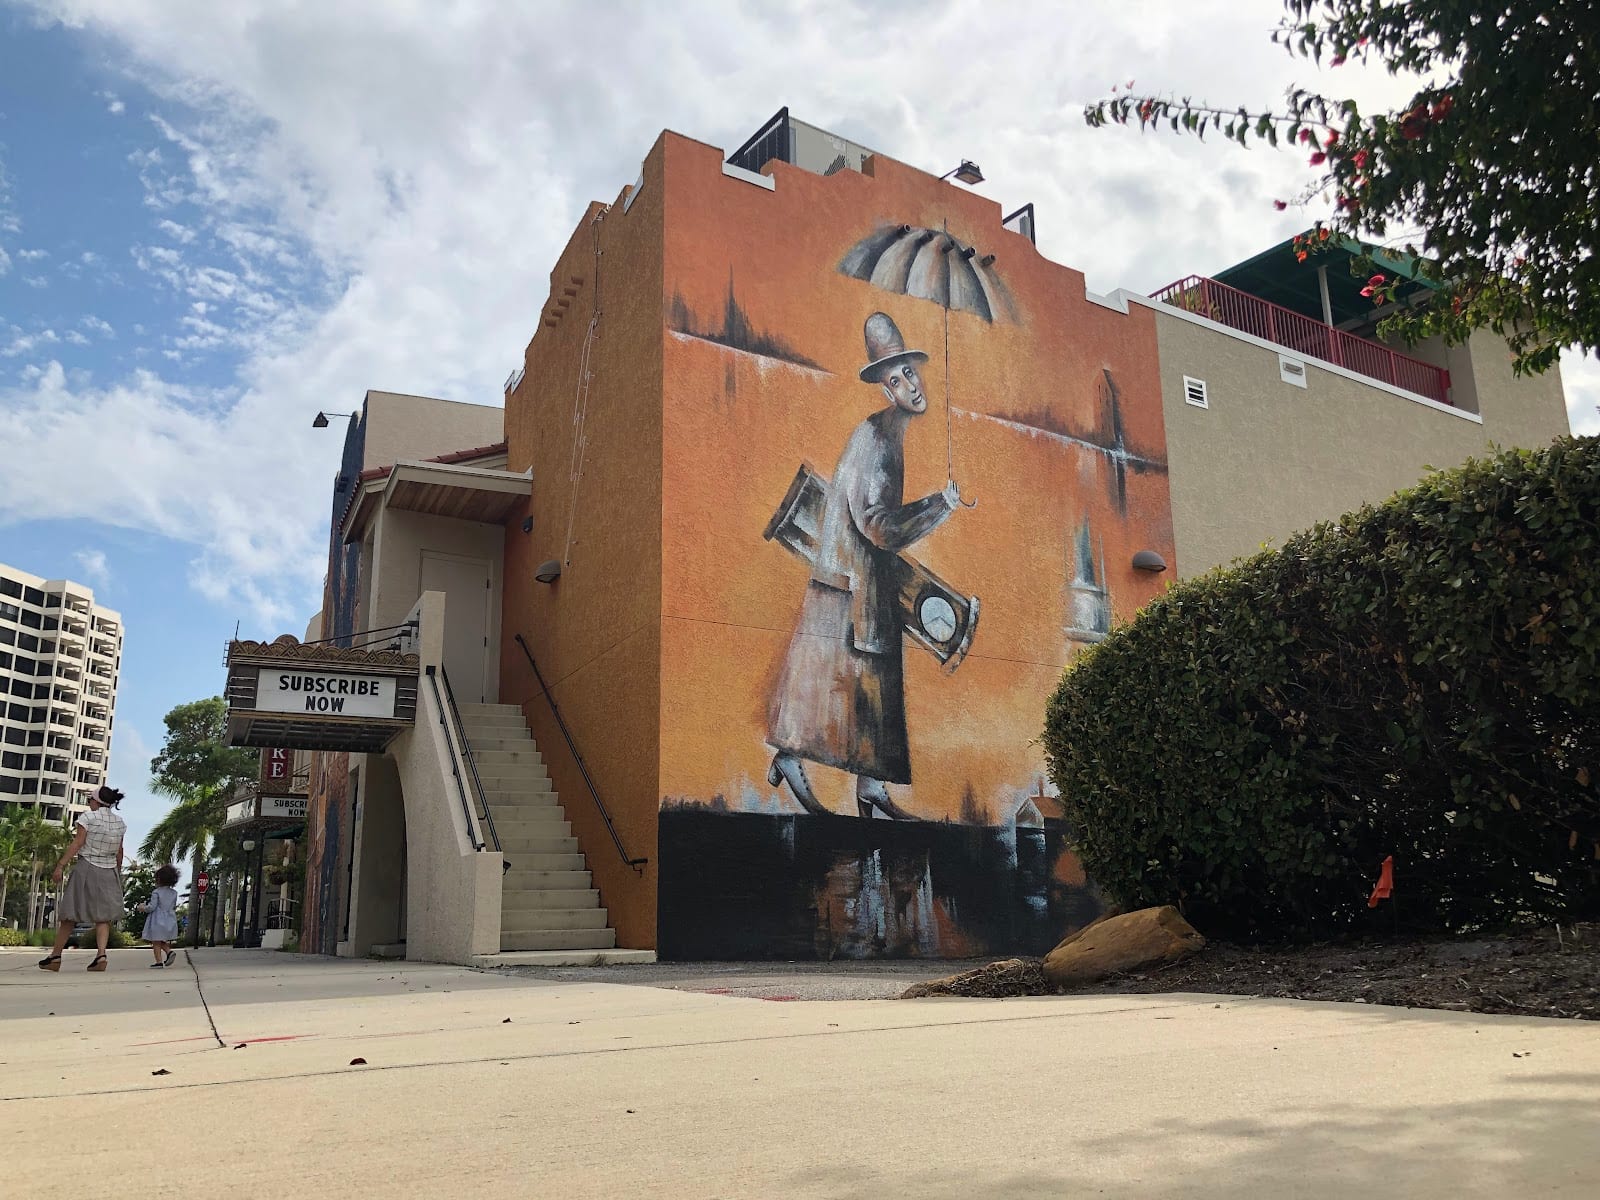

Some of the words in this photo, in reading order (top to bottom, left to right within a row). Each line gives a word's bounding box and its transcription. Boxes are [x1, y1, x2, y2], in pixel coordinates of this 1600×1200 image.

[279, 675, 380, 696] SUBSCRIBE
[305, 696, 345, 712] NOW
[272, 748, 286, 777] RE
[274, 800, 307, 808] SUBSCRI
